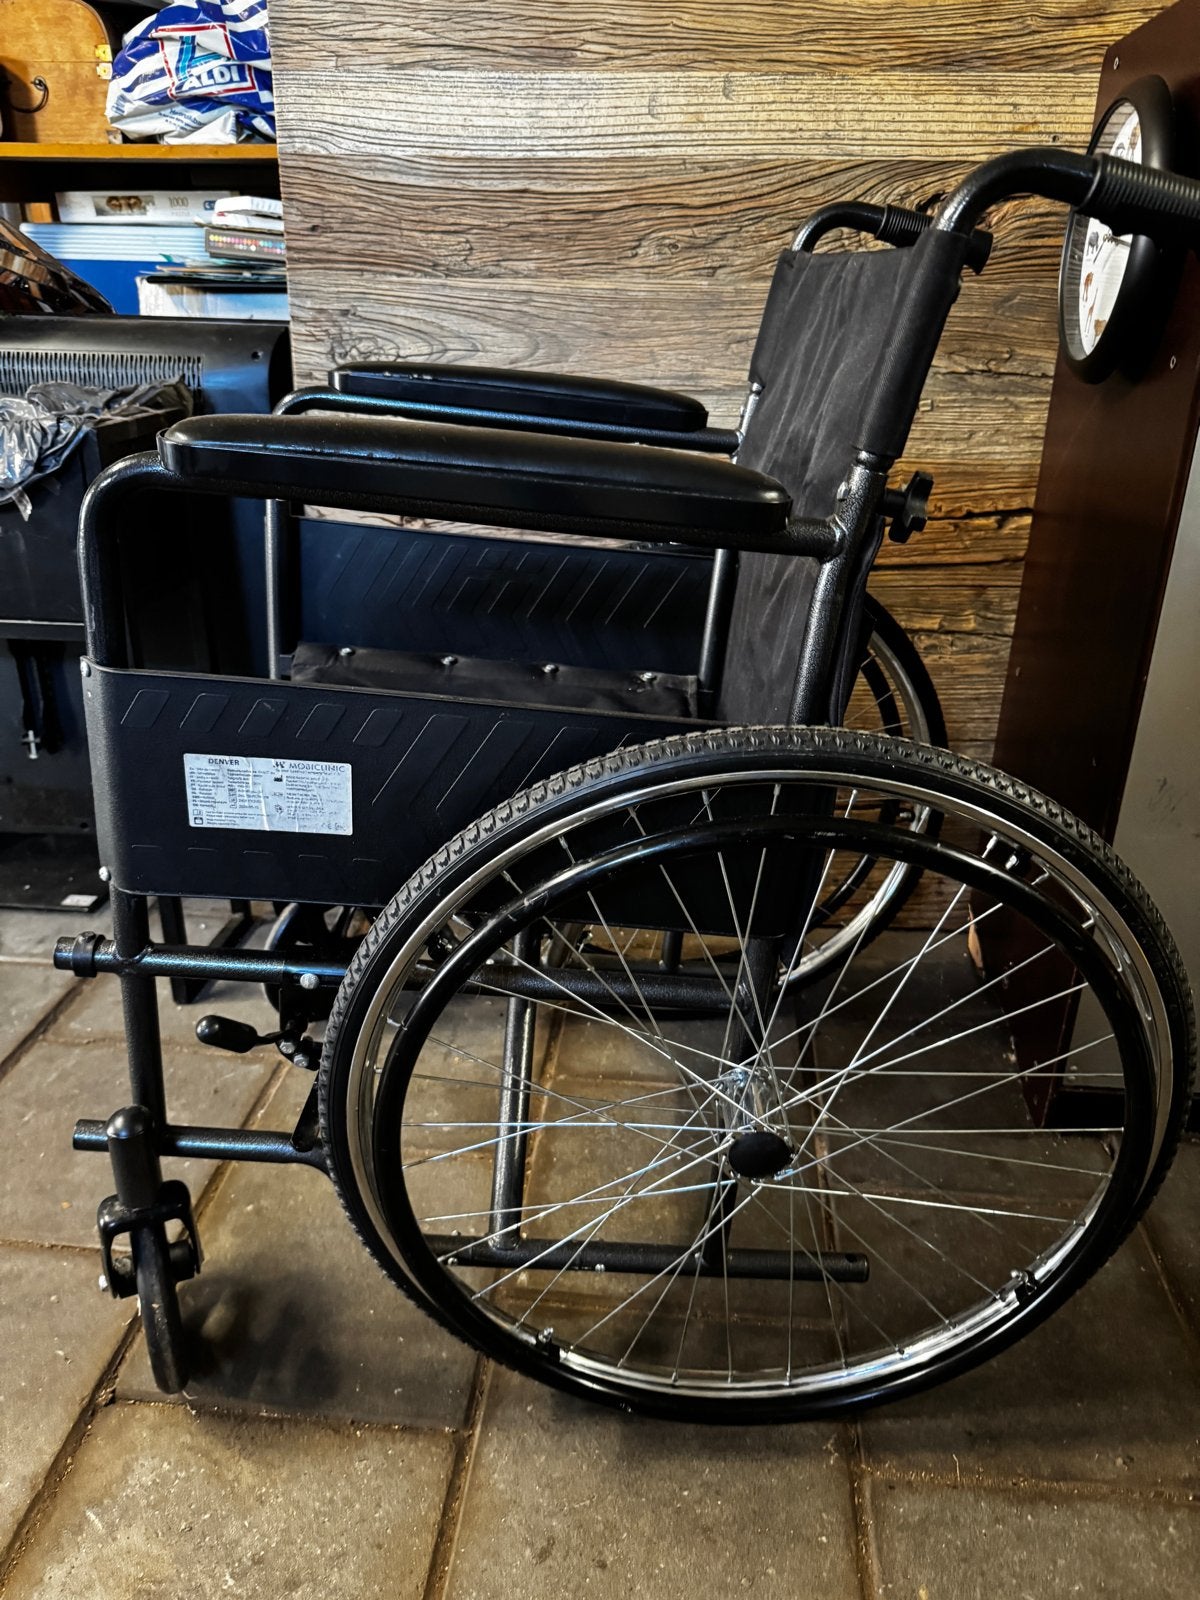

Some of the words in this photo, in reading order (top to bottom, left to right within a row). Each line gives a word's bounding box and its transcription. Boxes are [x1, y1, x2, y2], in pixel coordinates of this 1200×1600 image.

[181, 66, 241, 91] ALDI
[168, 195, 190, 208] 1000
[208, 758, 240, 767] DENVER
[289, 762, 346, 773] MOBICLINIC
